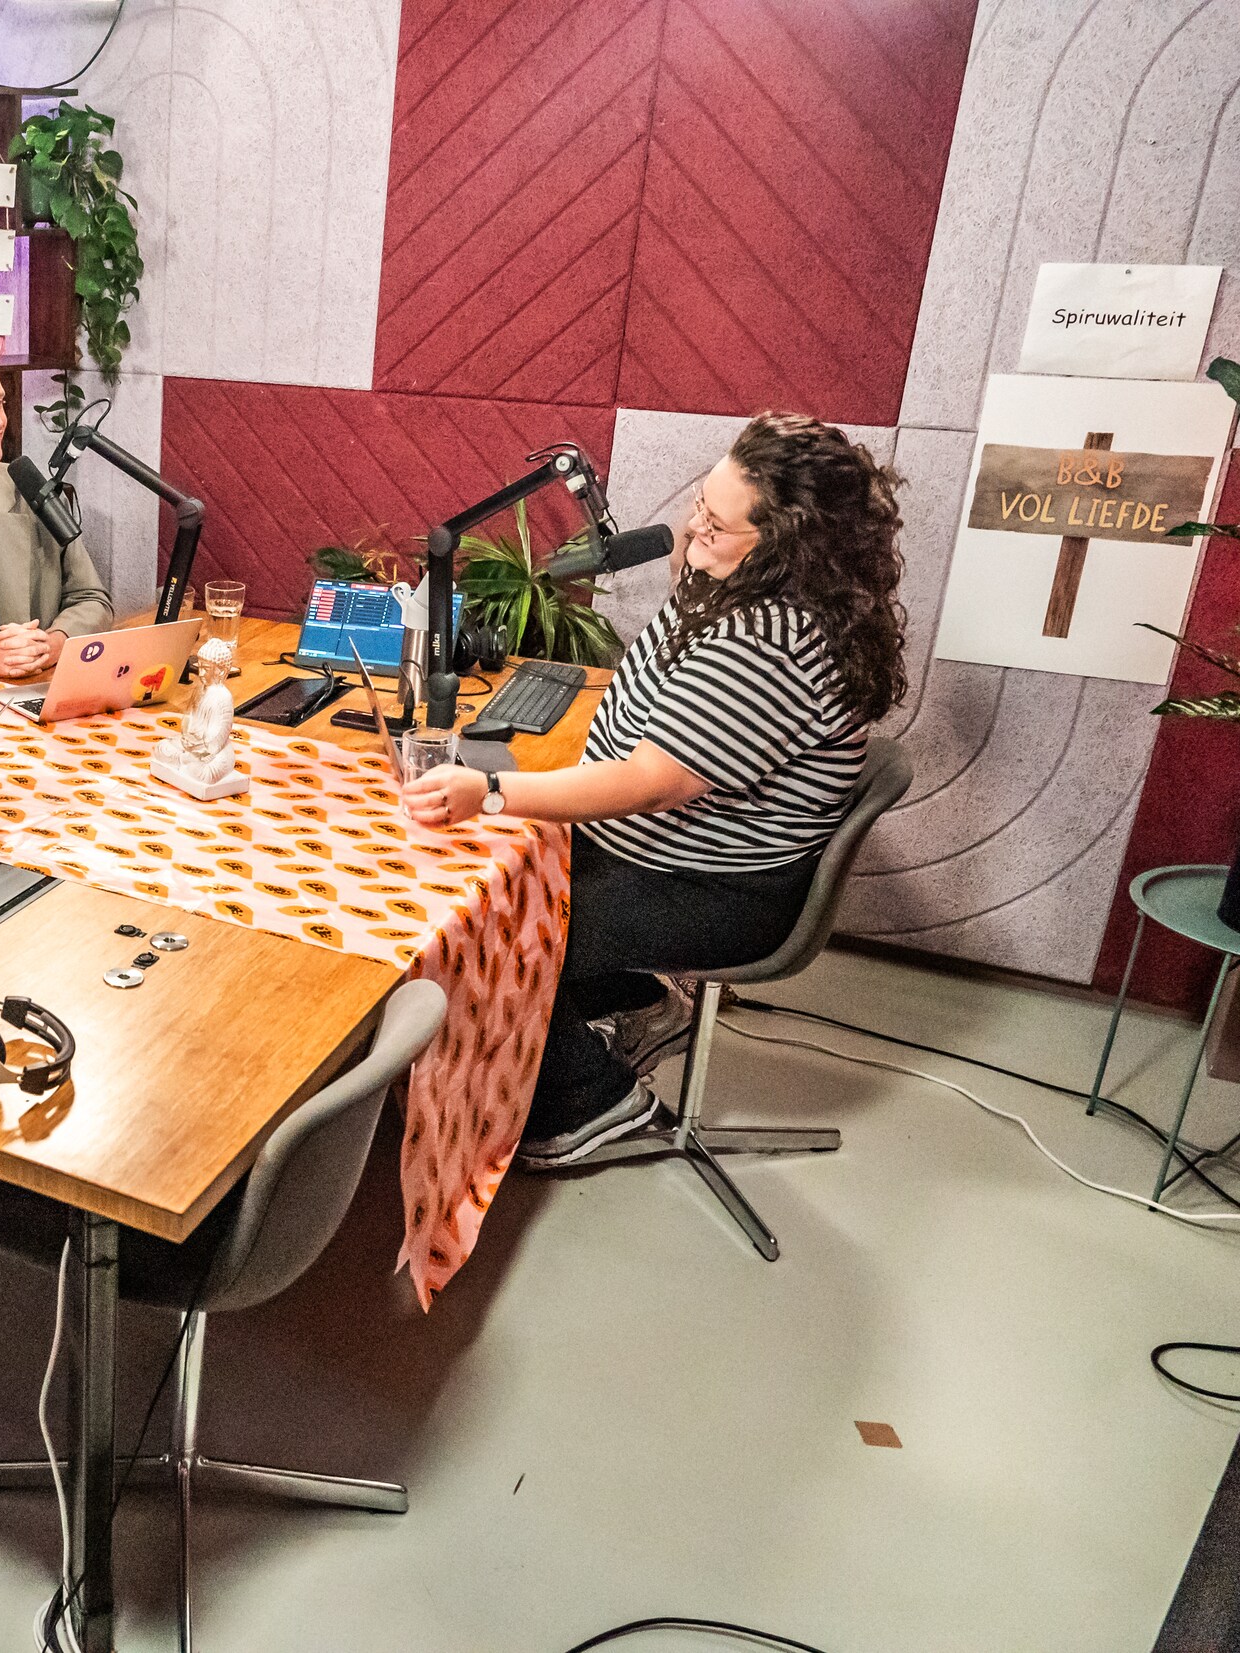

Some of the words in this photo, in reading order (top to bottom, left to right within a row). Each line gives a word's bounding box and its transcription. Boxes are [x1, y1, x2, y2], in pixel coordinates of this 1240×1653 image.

[1051, 308, 1187, 329] Spiruwaliteit
[1056, 453, 1125, 489] B&B
[1001, 492, 1056, 523] VOL
[1067, 496, 1169, 533] LIEFDE
[162, 584, 175, 617] YELLOWTEC
[432, 633, 440, 656] mika
